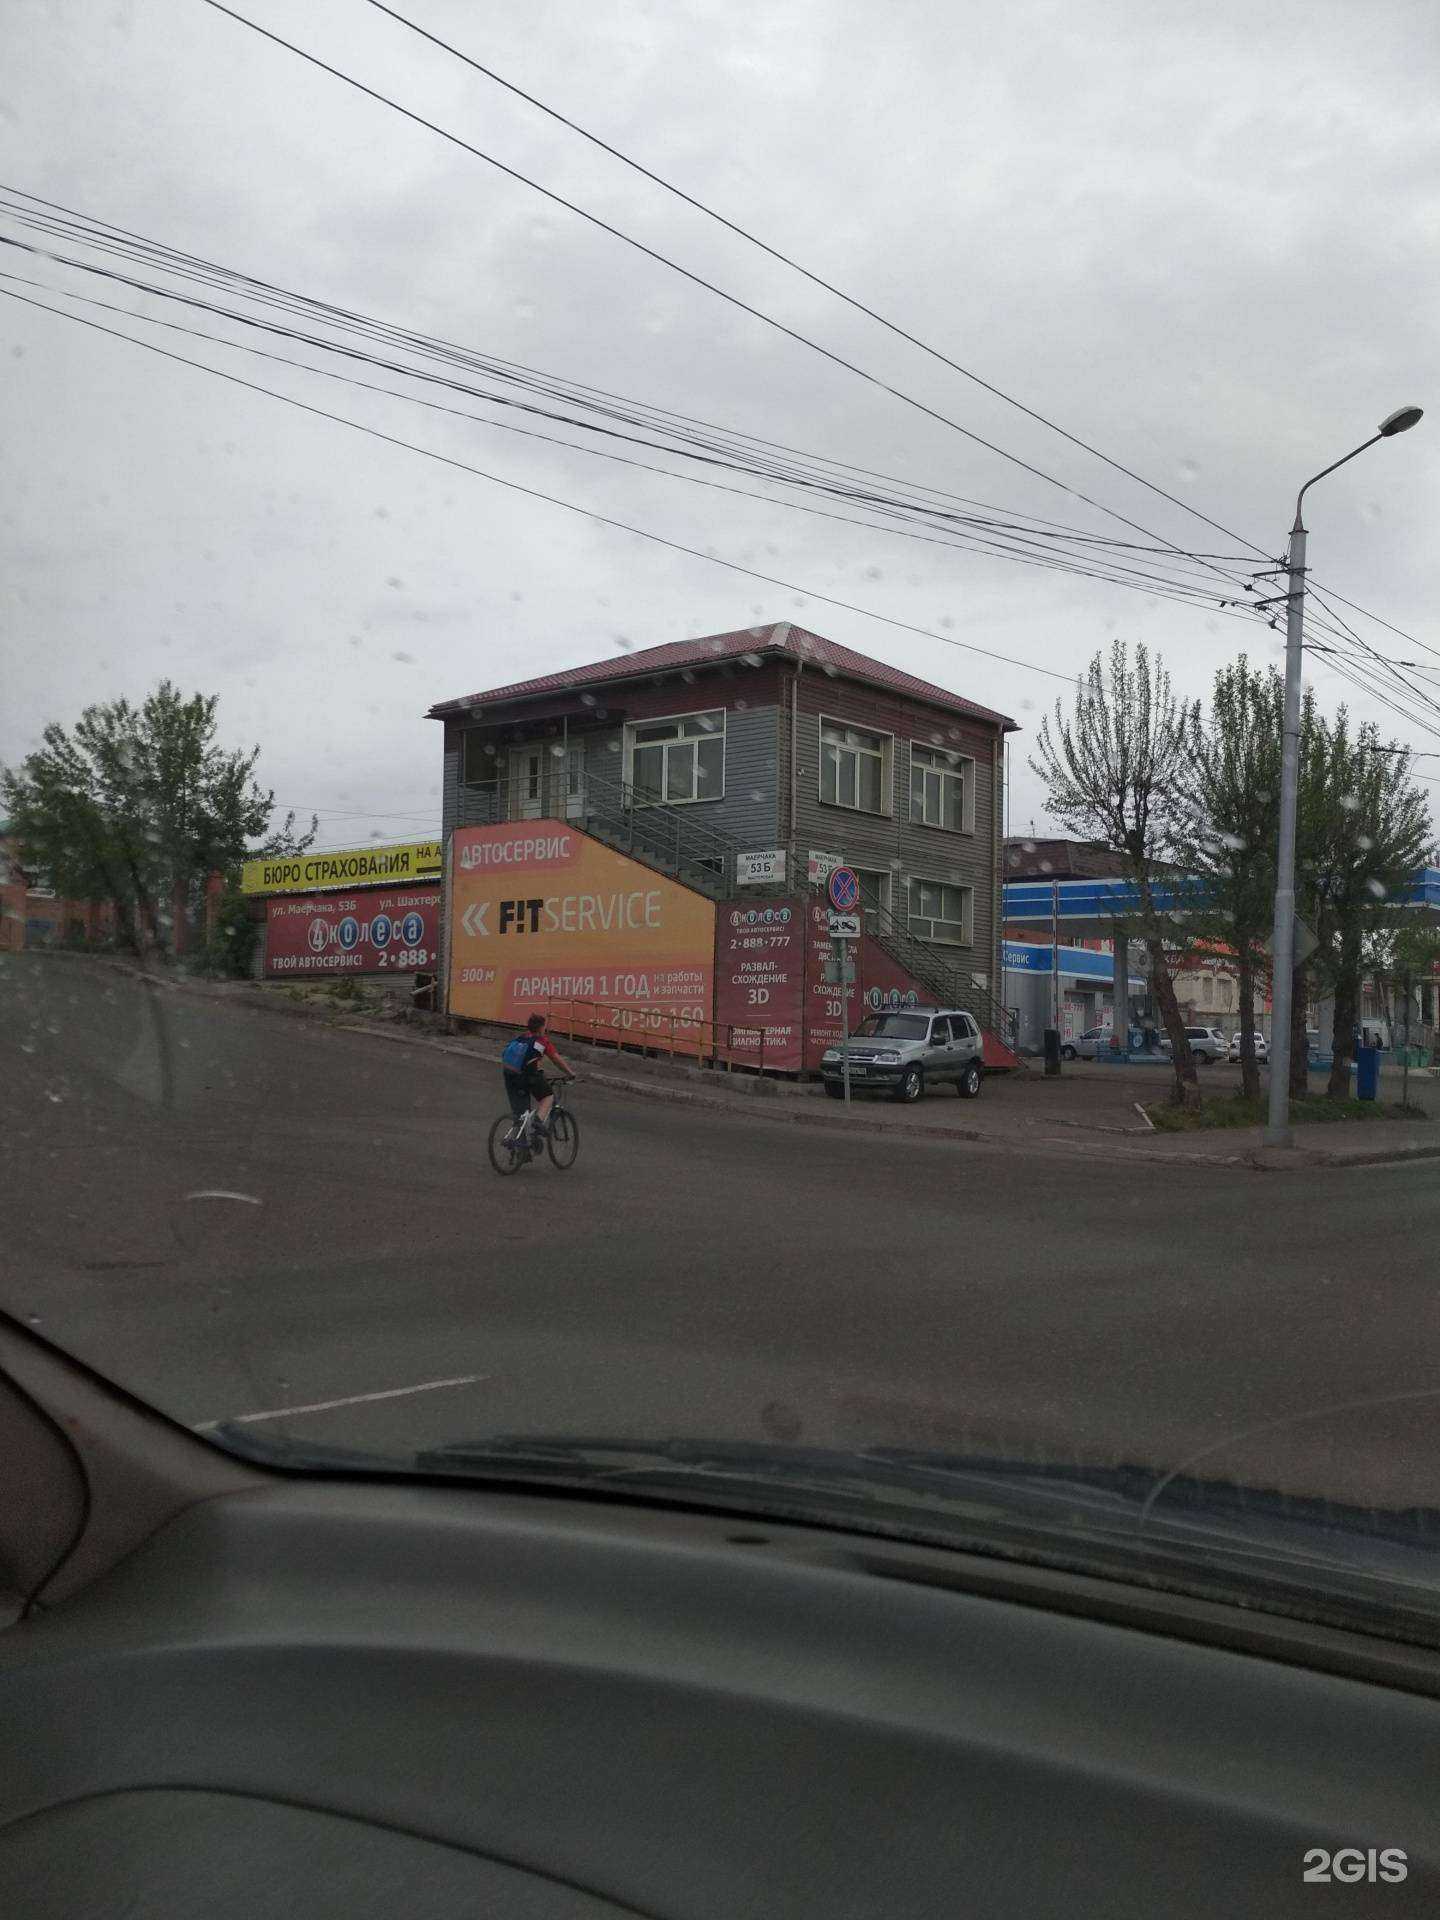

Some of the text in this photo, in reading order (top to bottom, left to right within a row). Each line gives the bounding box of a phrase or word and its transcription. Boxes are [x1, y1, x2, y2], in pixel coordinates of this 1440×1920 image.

[416, 848, 431, 859] НА
[460, 836, 570, 869] АВТОСЕРВИС
[263, 852, 410, 885] БЮРО СТРАХОВАНИЯ
[272, 956, 299, 969] ТВОЙ
[740, 961, 778, 972] РАЗВАЛ-
[461, 967, 483, 983] 300
[732, 973, 788, 985] СХОЖДЕНИЕ
[513, 976, 595, 997] ГАРАНТИЯ
[599, 975, 609, 996] 1
[614, 974, 649, 998] ГОД
[666, 969, 703, 983] работы
[747, 988, 770, 1005] 3D
